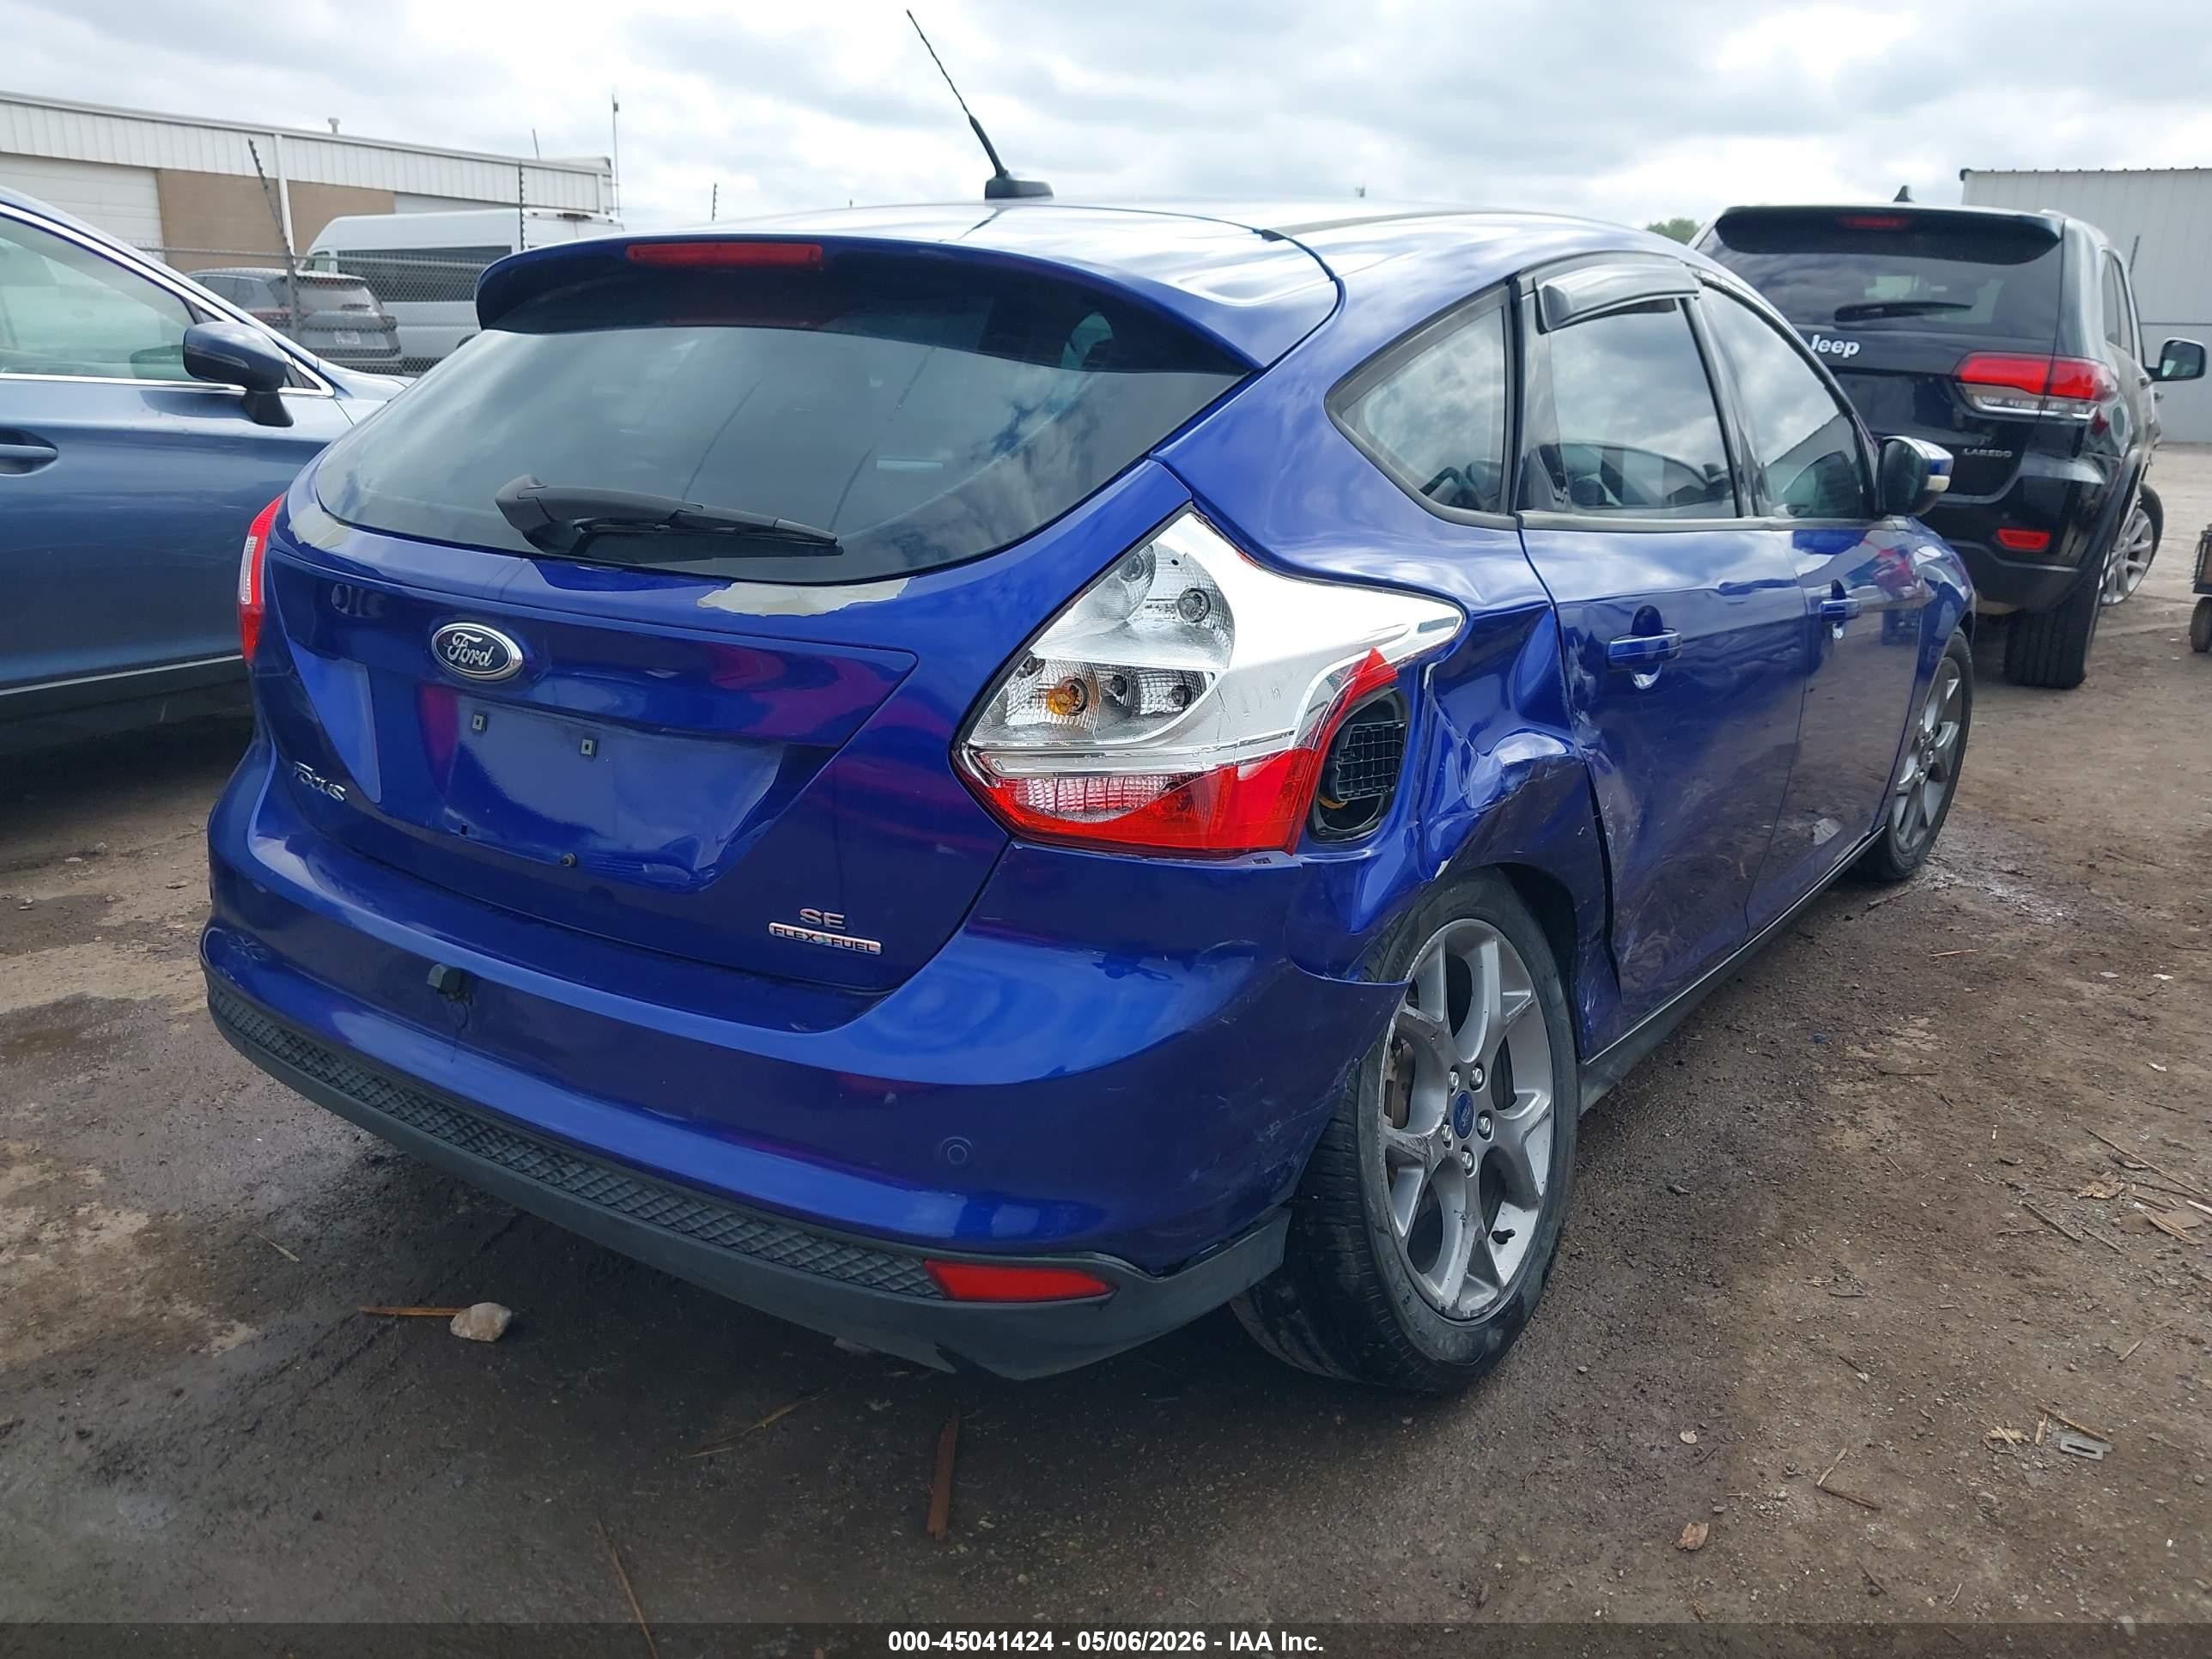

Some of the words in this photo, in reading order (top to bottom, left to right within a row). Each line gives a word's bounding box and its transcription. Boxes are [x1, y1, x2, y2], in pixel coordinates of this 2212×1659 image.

[1811, 334, 1860, 358] Jeep
[1963, 447, 2013, 459] LAREDO
[444, 632, 495, 666] Ford
[799, 908, 846, 930] SE
[773, 927, 817, 943] FLEX
[830, 938, 877, 953] FUEL
